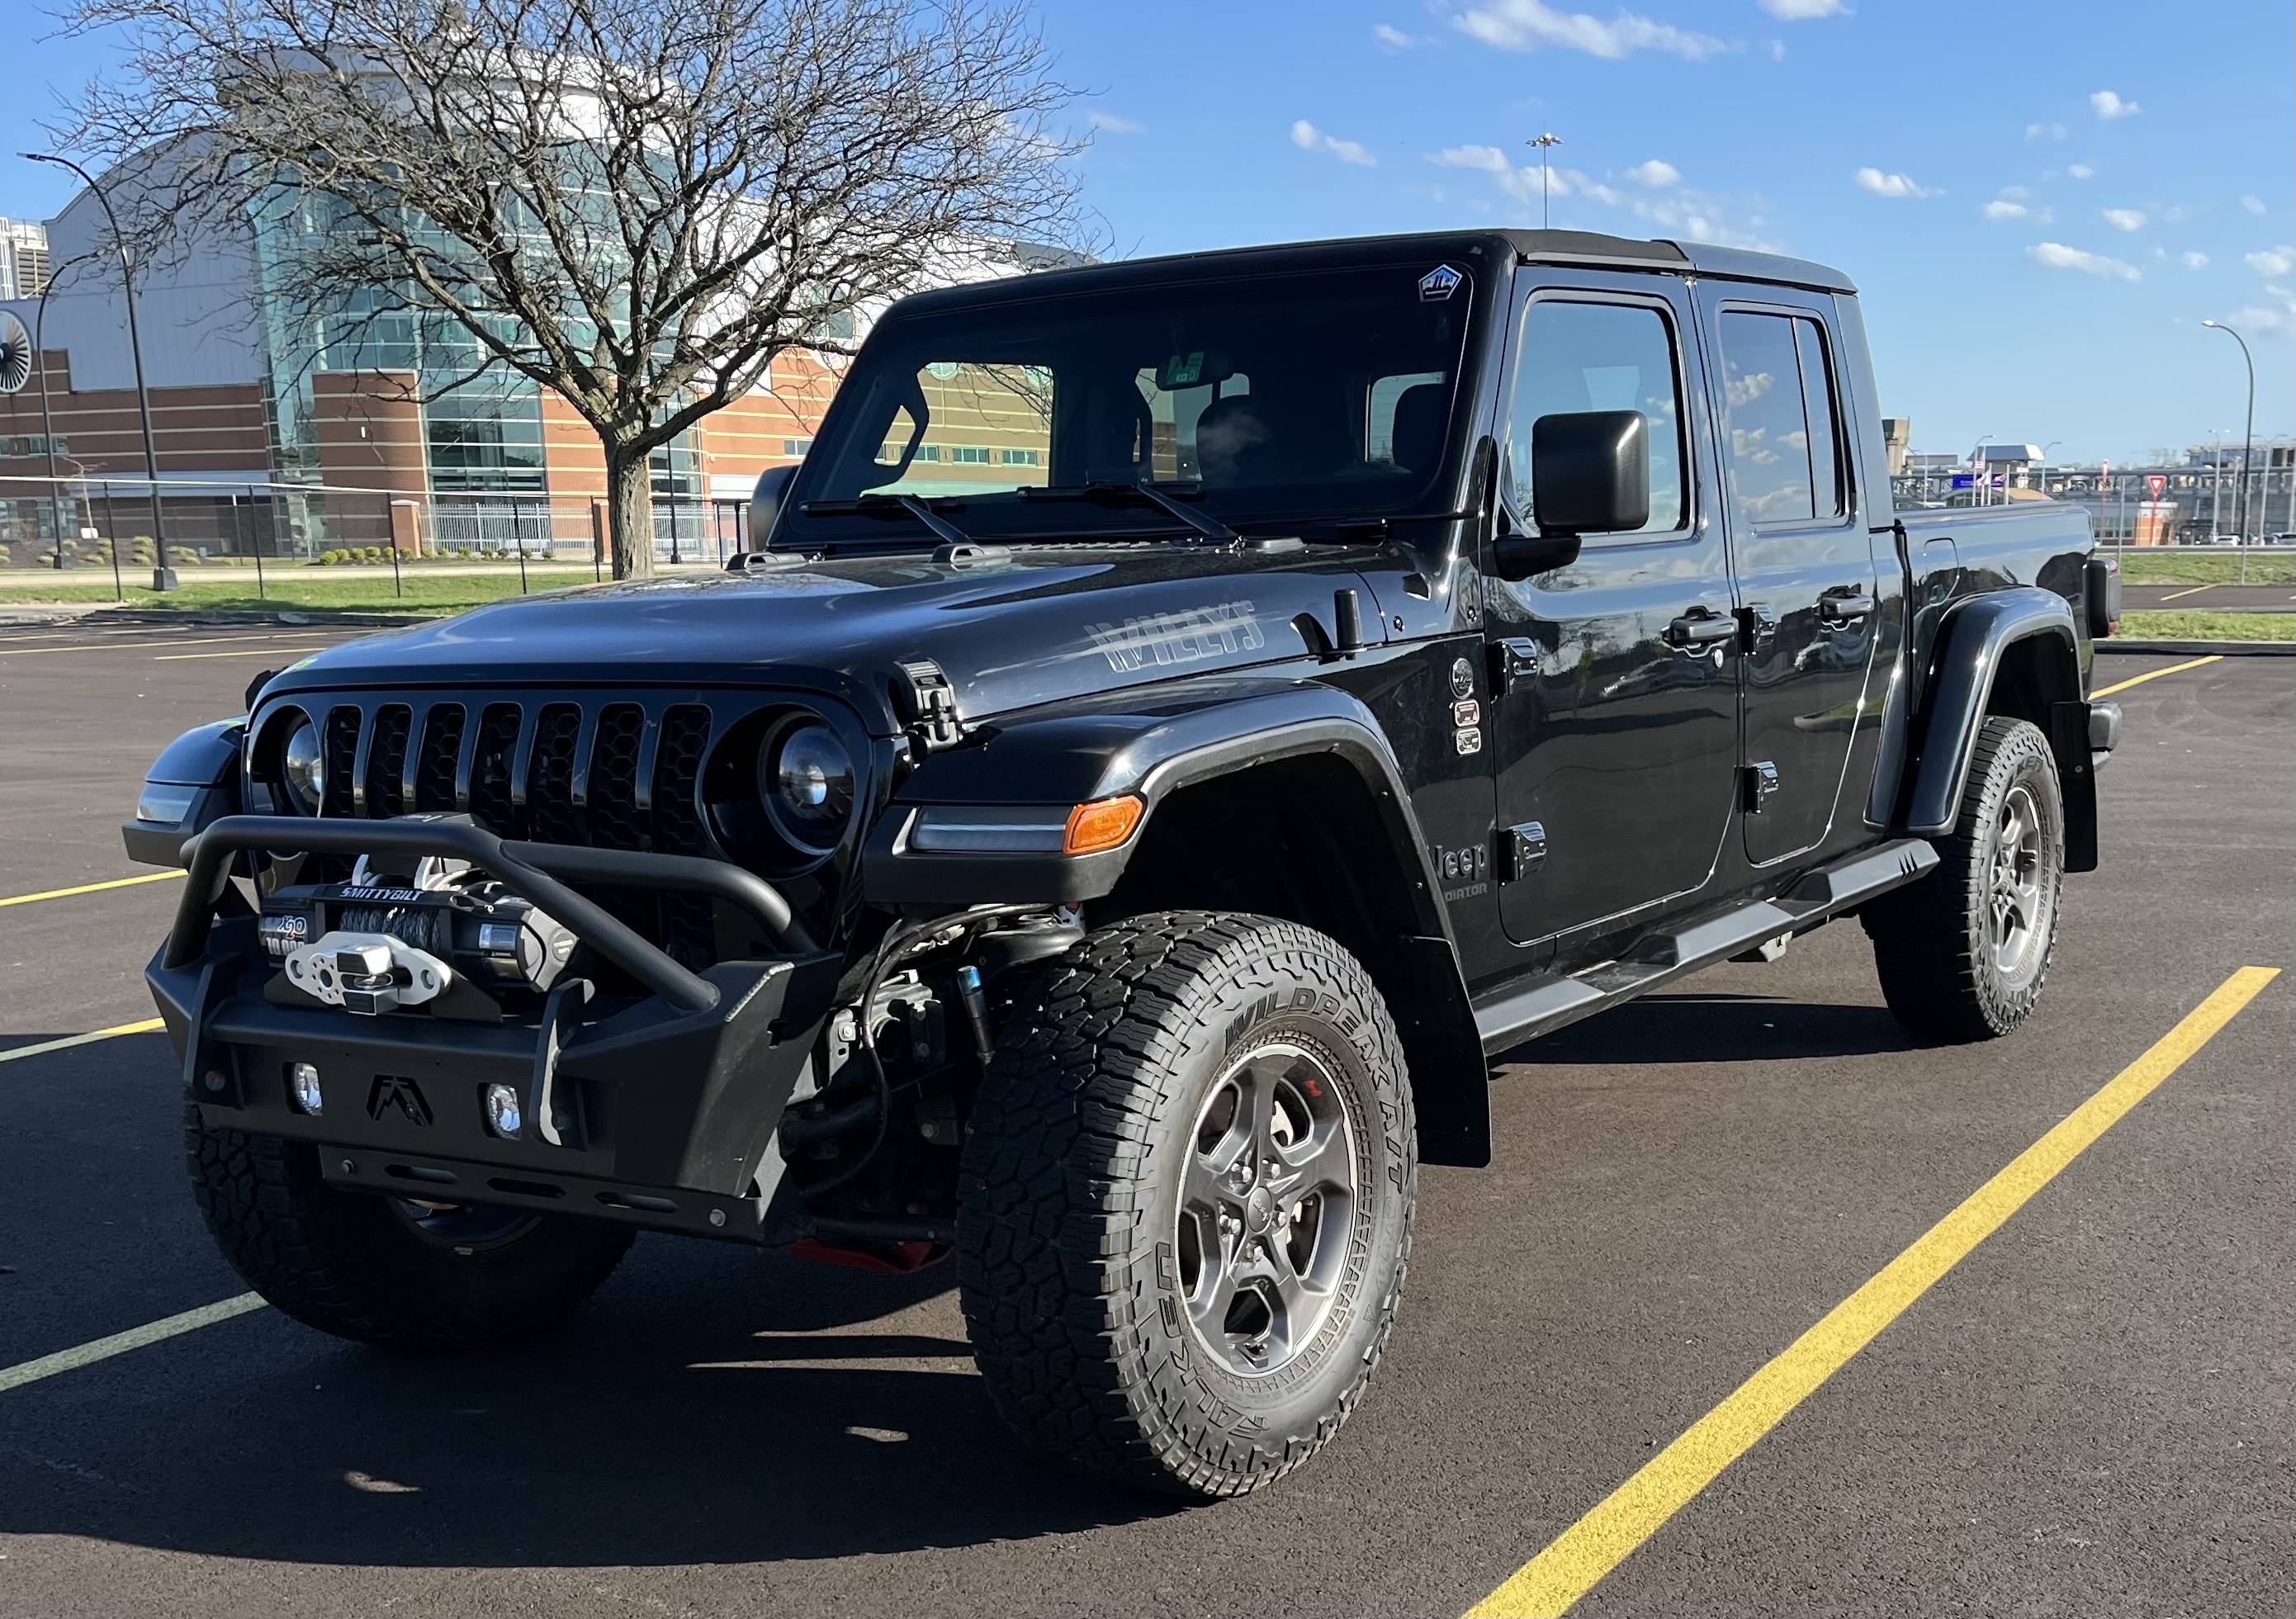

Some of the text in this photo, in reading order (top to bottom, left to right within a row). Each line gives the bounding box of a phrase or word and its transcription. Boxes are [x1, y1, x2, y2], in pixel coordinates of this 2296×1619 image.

[1083, 600, 1265, 673] WILLYS
[1433, 844, 1486, 882] Jeep
[339, 887, 424, 902] SMITTYBILT
[1444, 883, 1488, 902] DIATOR
[1224, 987, 1391, 1091] WILDPEAK
[1156, 1241, 1271, 1440] FALKEN
